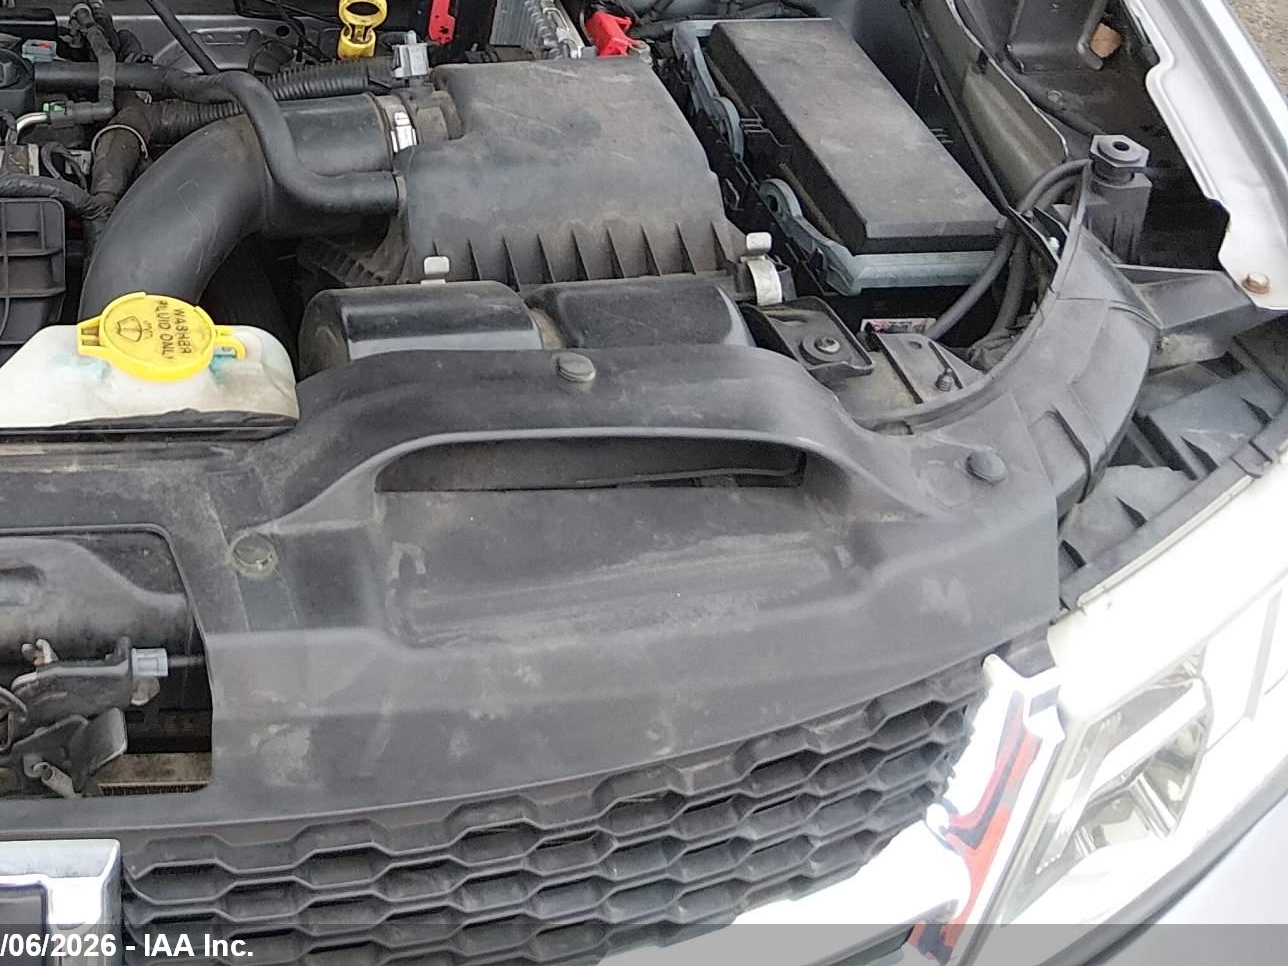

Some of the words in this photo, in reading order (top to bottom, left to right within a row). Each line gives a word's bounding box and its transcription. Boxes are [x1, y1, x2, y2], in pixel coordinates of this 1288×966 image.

[155, 300, 171, 330] FLUID
[173, 308, 192, 354] WASHER
[159, 334, 174, 360] ONLY
